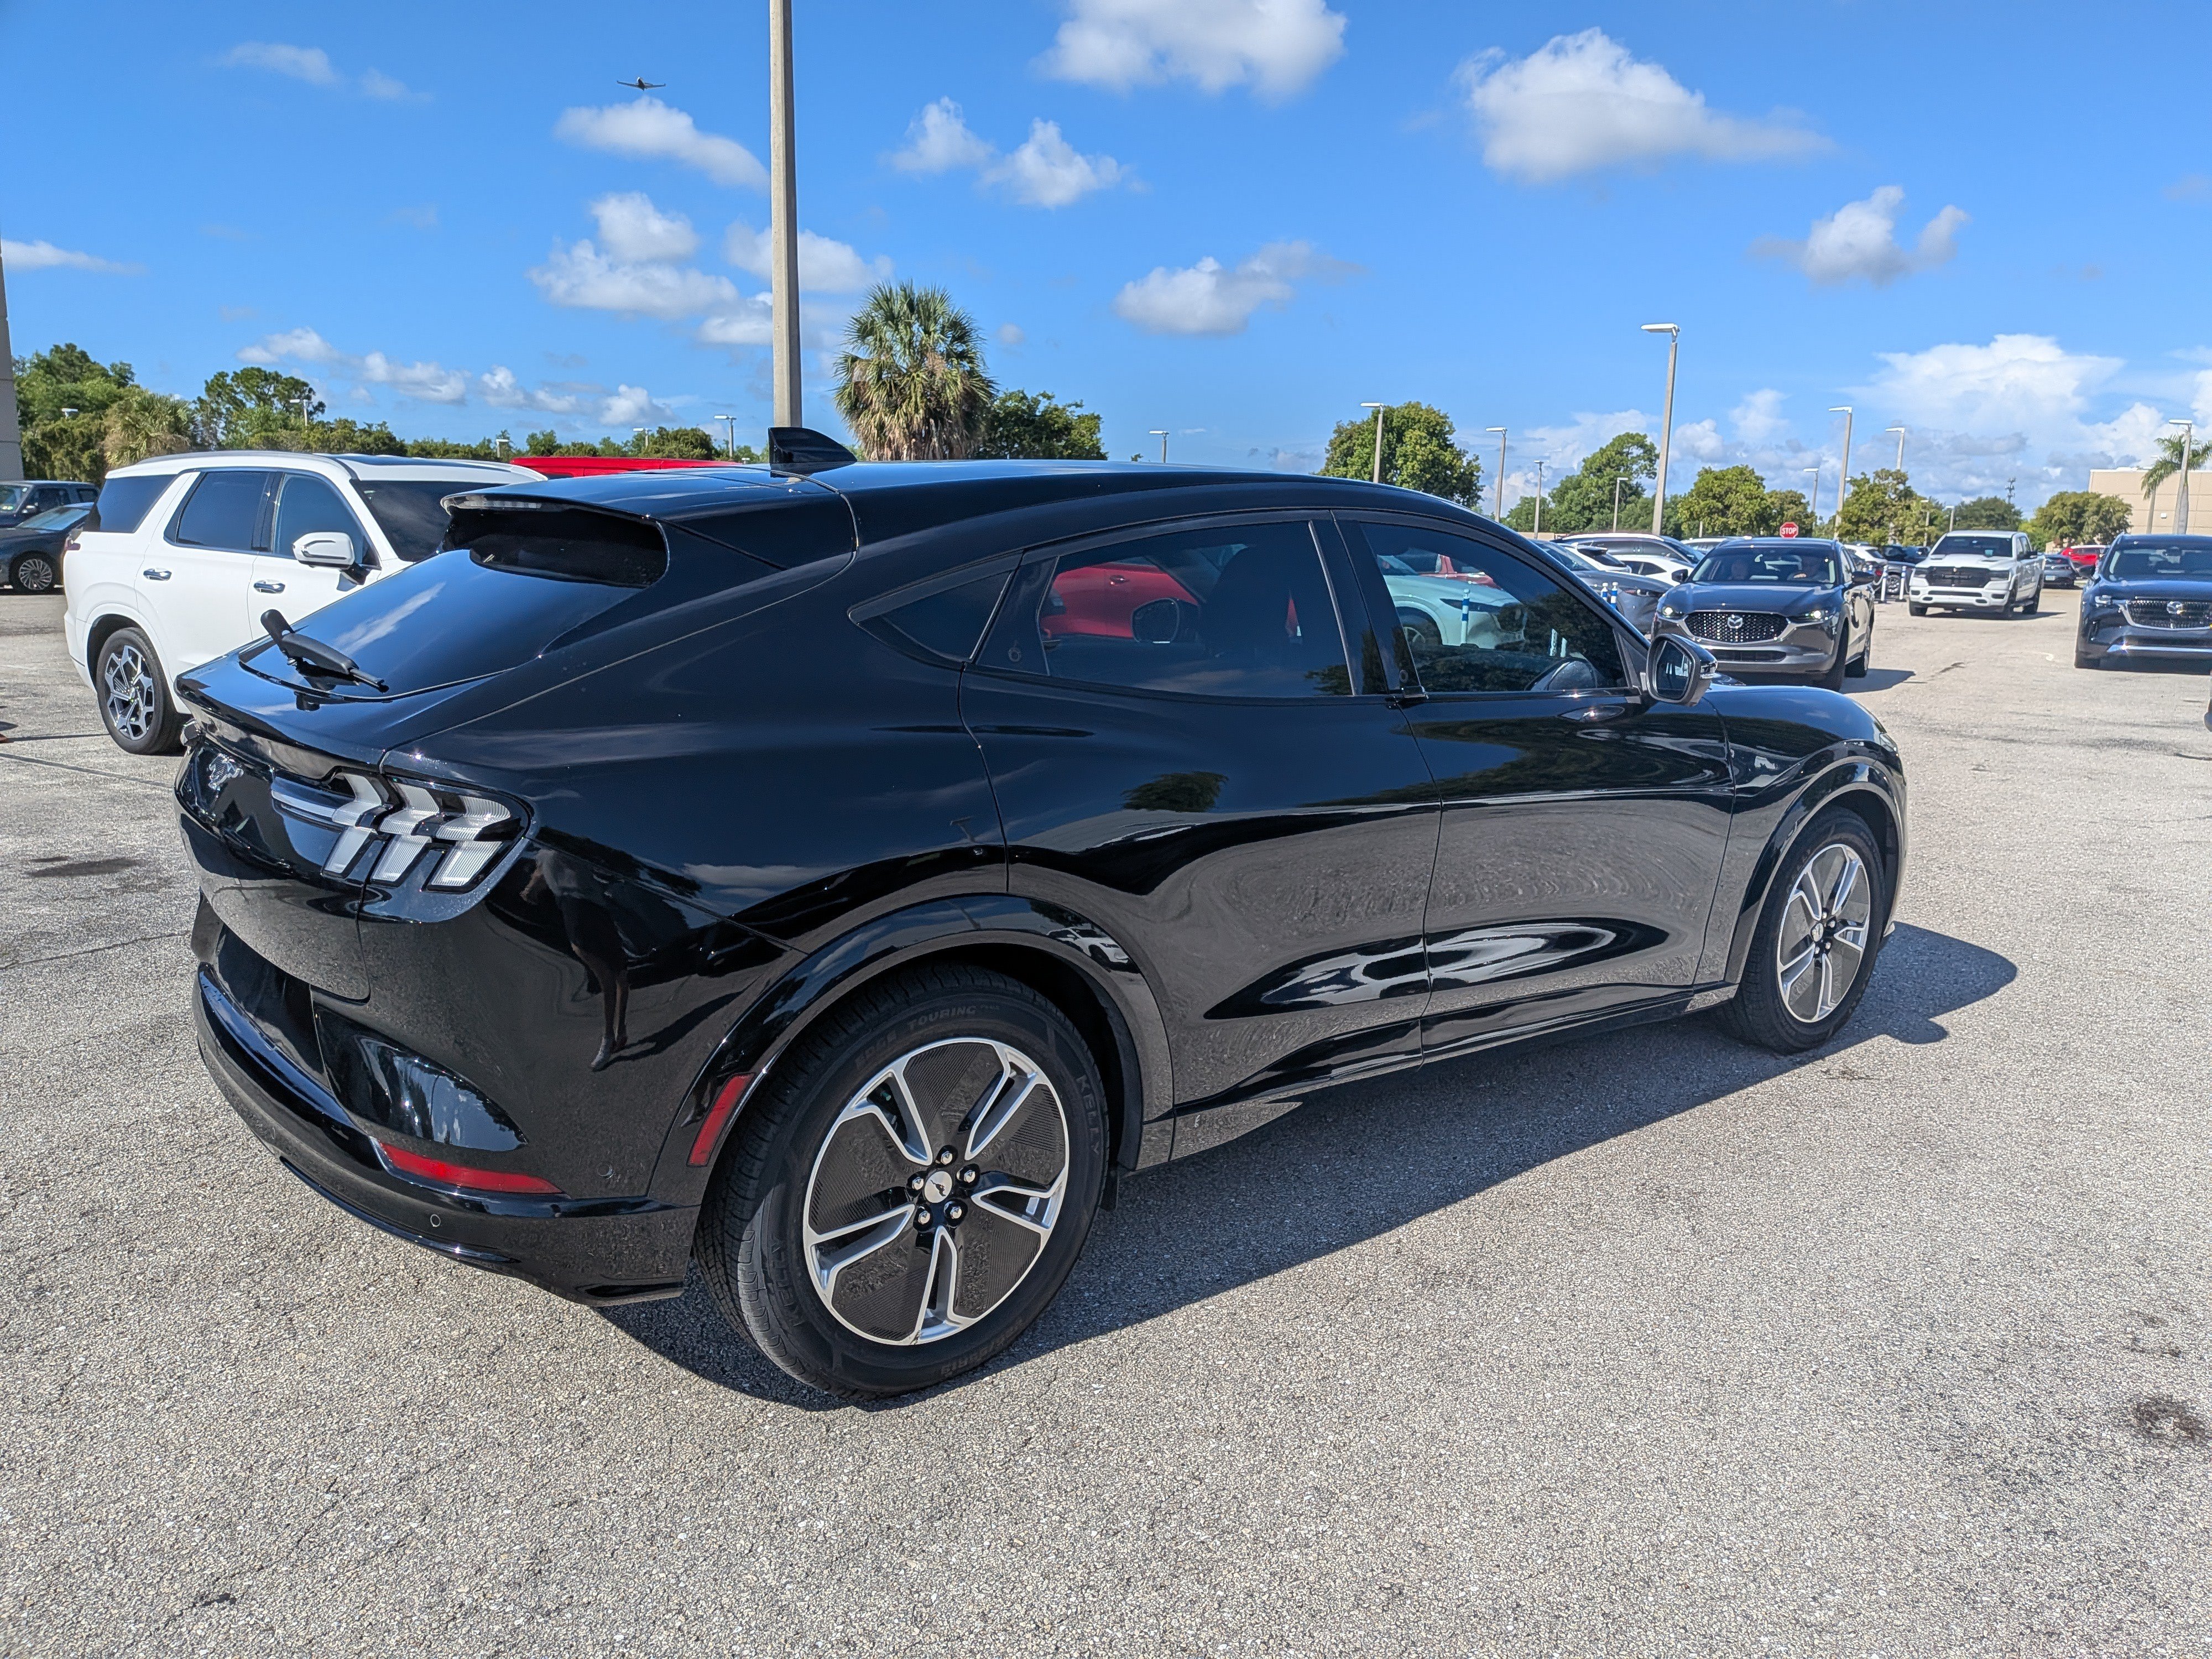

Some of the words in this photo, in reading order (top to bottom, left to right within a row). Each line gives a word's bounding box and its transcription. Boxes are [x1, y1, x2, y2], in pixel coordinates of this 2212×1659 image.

[907, 1005, 978, 1030] TOURING
[1075, 1074, 1100, 1155] KELLY
[770, 1233, 805, 1327] KELLY
